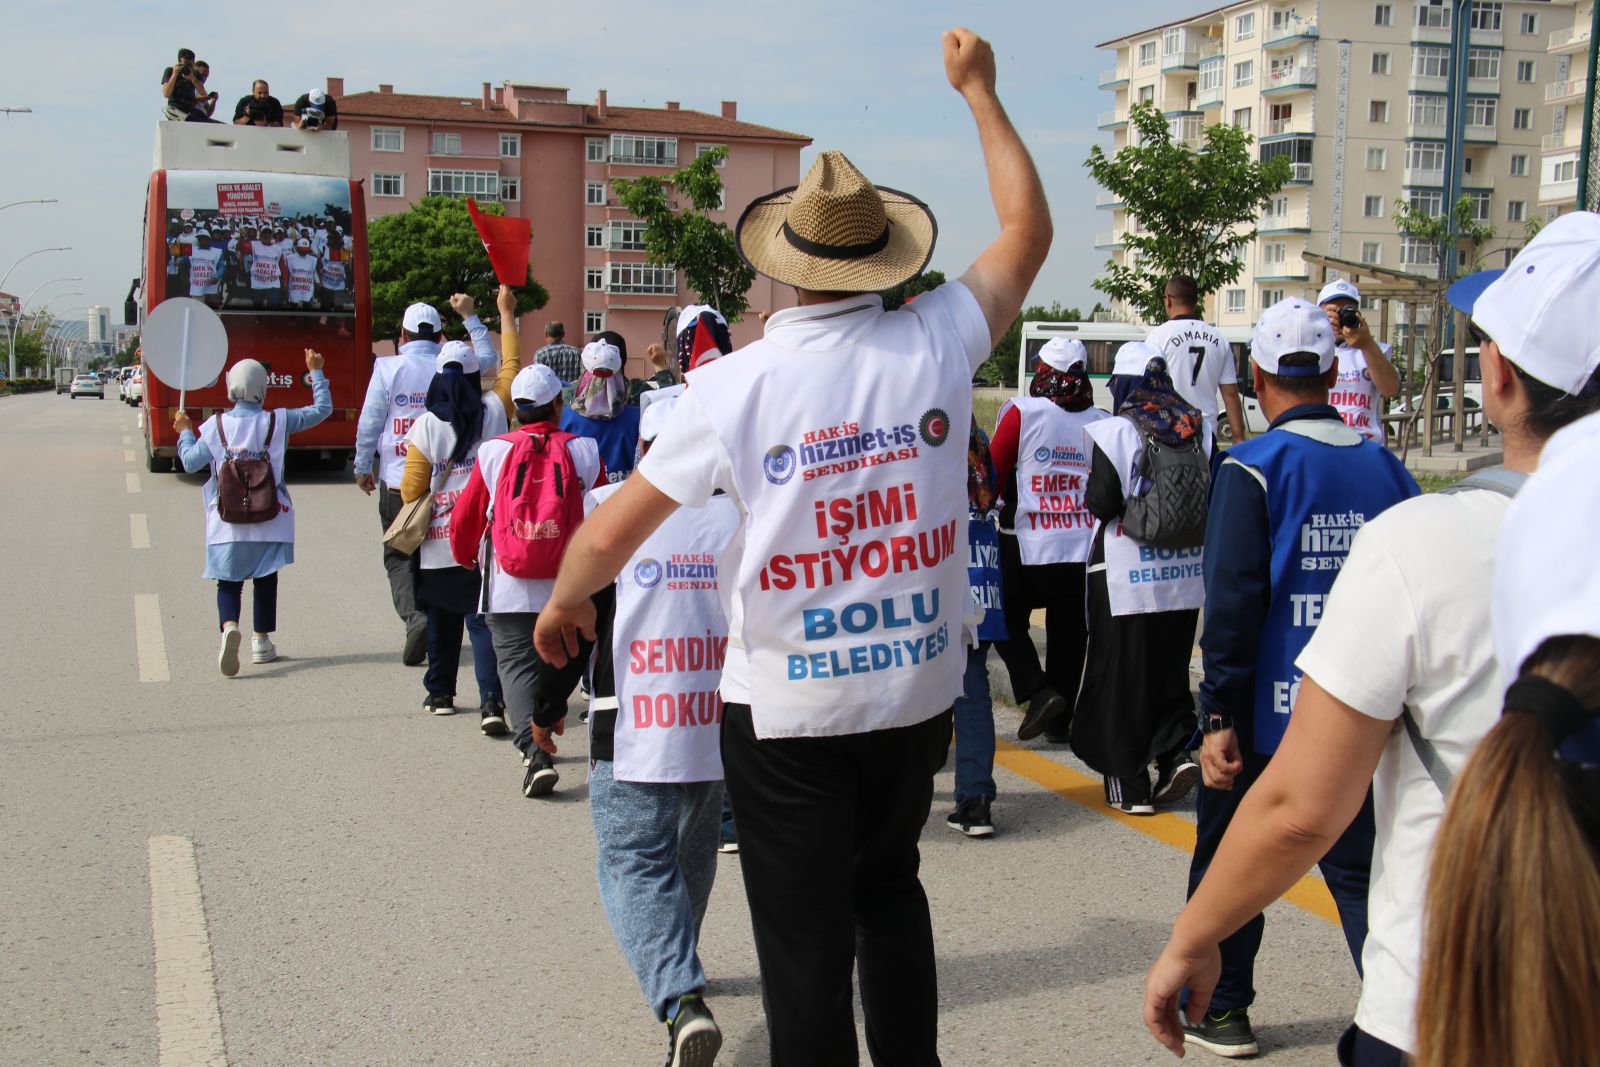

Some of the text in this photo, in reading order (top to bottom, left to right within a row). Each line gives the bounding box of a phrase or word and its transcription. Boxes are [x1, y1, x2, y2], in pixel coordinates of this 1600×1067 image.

[1171, 330, 1219, 347] DI MARIA
[1188, 346, 1206, 387] 7
[803, 447, 919, 482] SENDİKASI
[1031, 474, 1081, 493] EMEK
[515, 519, 560, 540] NIKE
[666, 560, 718, 579] hizm
[1128, 562, 1204, 584] BELEDİYE
[802, 587, 940, 642] BOLU
